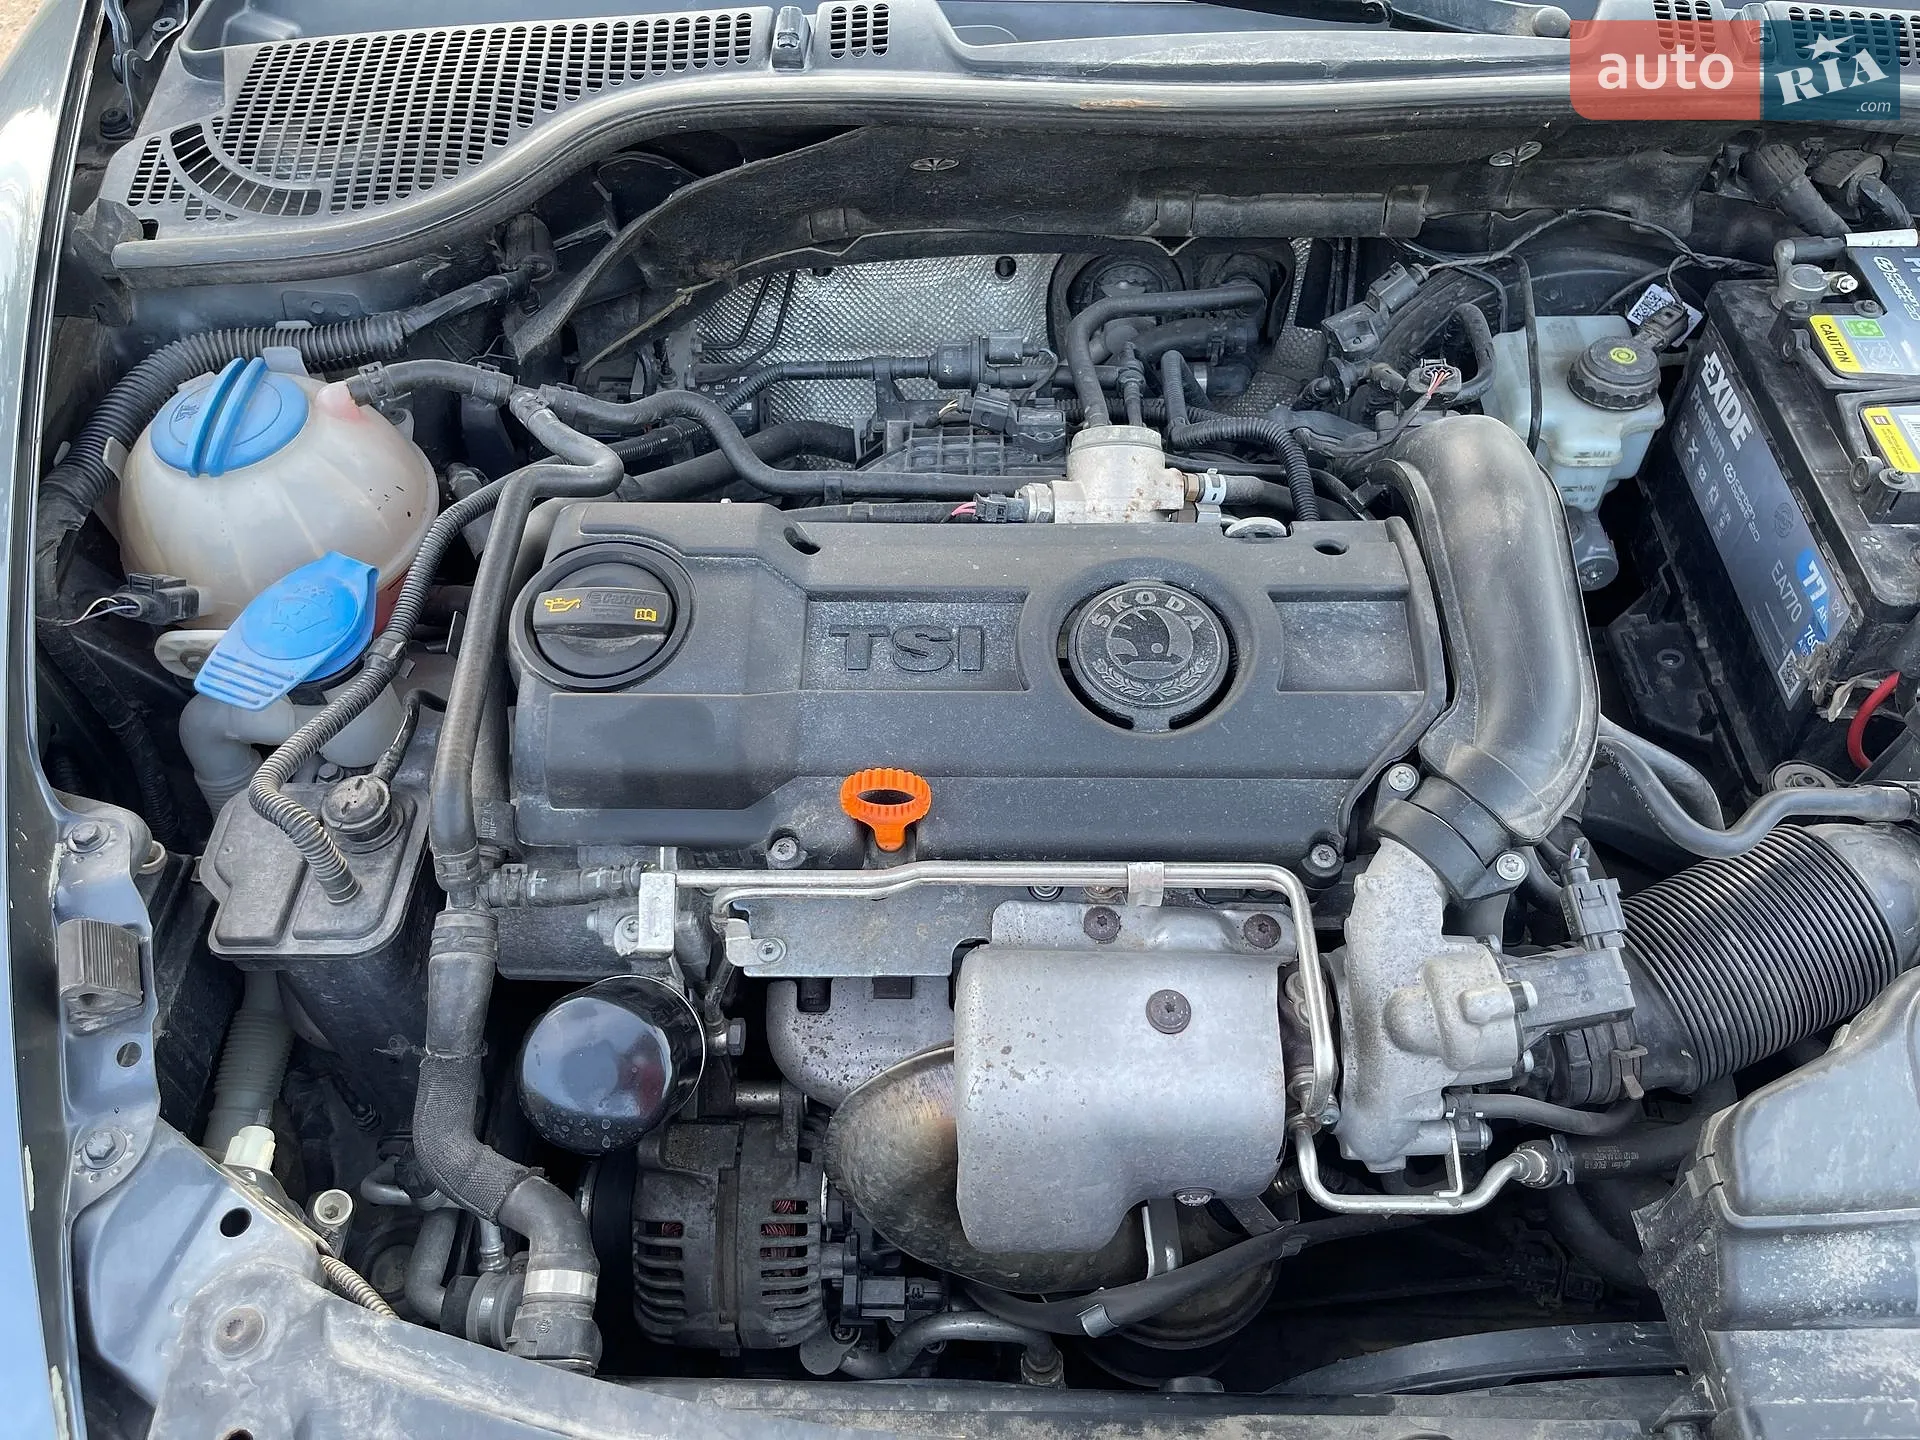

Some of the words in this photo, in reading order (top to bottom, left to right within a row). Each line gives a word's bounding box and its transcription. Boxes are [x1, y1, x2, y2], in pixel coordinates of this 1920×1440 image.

[1819, 323, 1851, 365] CAUTION
[1690, 383, 1725, 463] Premium
[1700, 350, 1752, 451] EXIDE
[1771, 559, 1803, 623] EA770
[1802, 559, 1828, 602] 77
[1816, 605, 1828, 624] Ah
[829, 624, 985, 672] TSI
